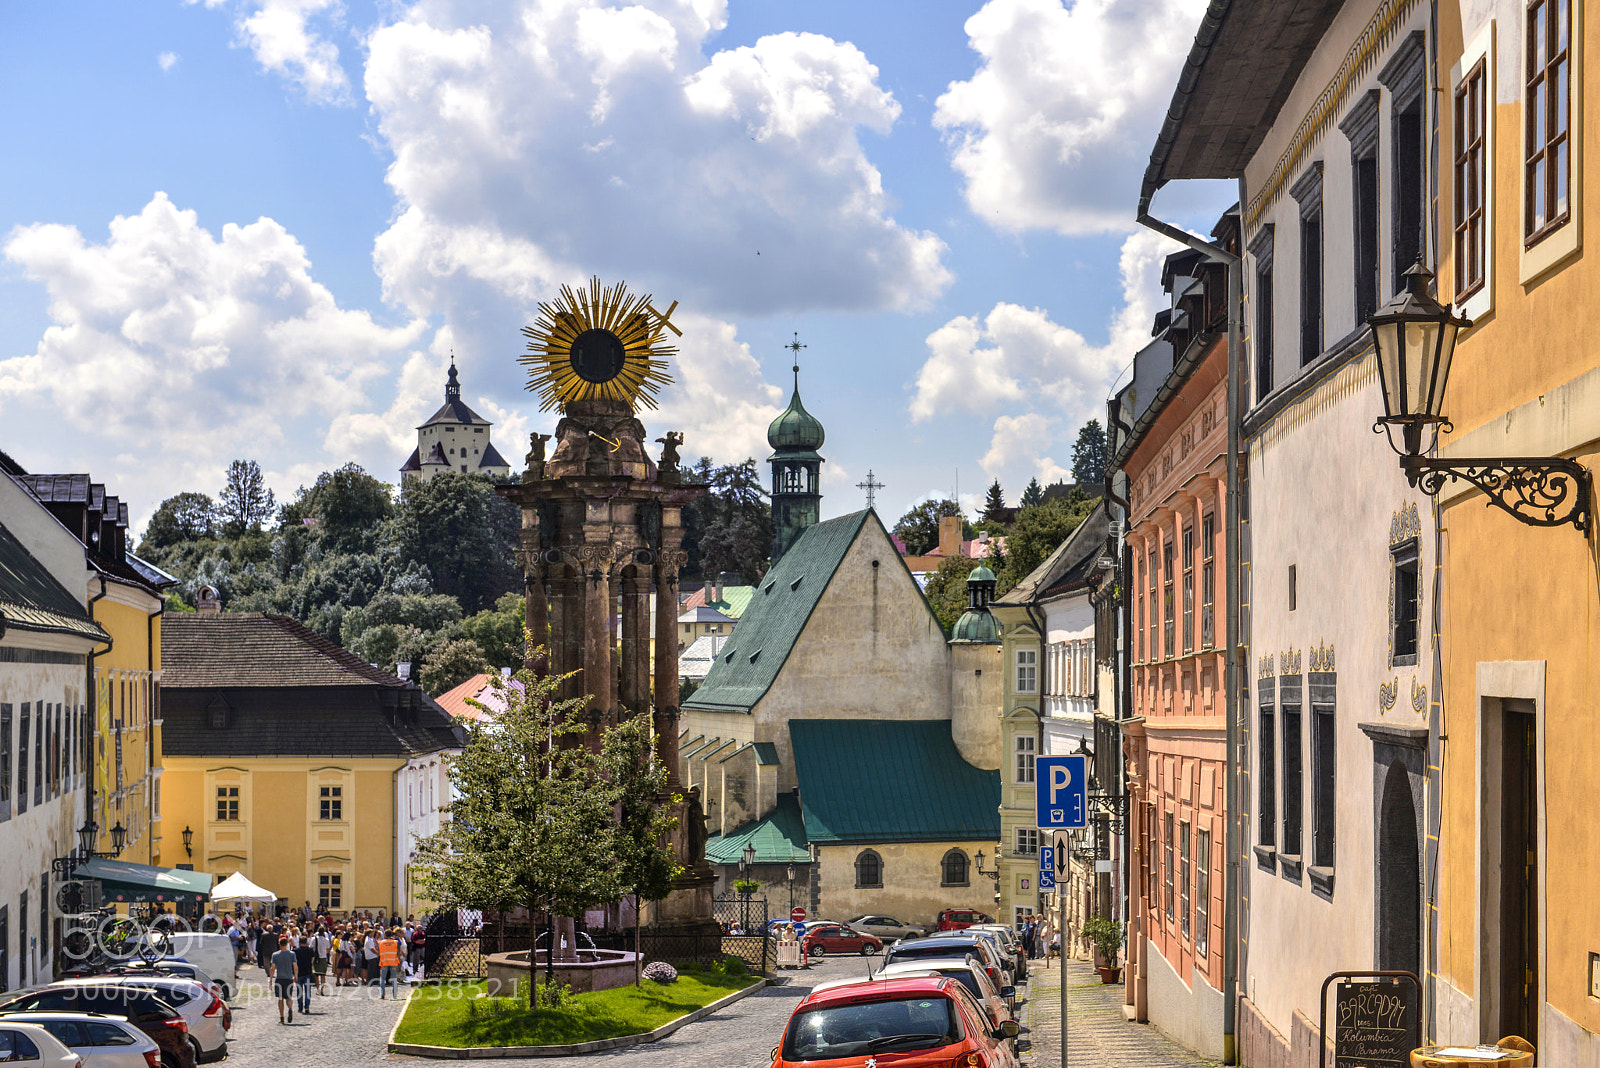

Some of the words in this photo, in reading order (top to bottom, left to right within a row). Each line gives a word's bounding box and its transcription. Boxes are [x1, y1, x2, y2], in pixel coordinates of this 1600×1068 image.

[1049, 765, 1072, 804] P
[1044, 849, 1052, 862] P
[1338, 1029, 1395, 1042] Kolumbia
